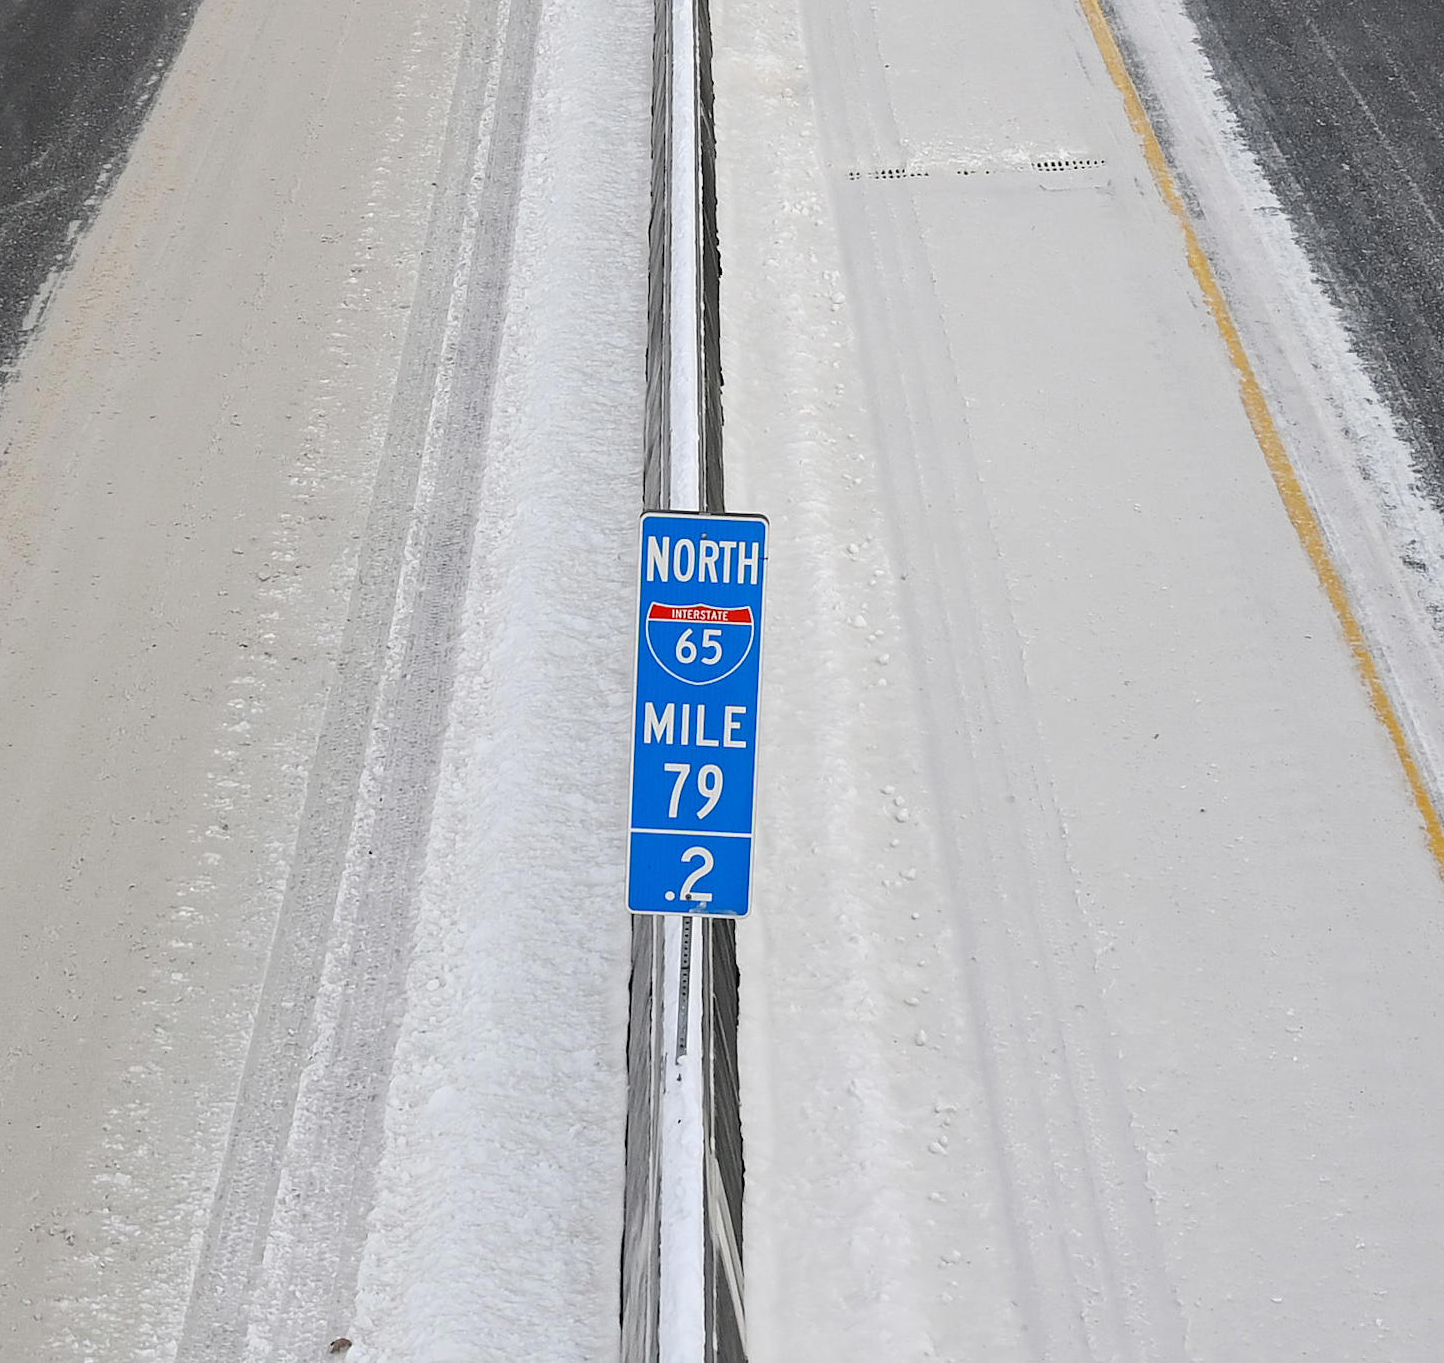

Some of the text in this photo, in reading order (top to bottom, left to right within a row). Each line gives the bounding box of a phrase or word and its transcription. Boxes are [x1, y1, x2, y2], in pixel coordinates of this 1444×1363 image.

[647, 536, 758, 584] NORTH
[671, 608, 730, 622] INTERSTATE
[676, 629, 722, 664] 65
[644, 702, 746, 747] MILE
[665, 764, 723, 819] 79
[665, 847, 713, 902] .2
